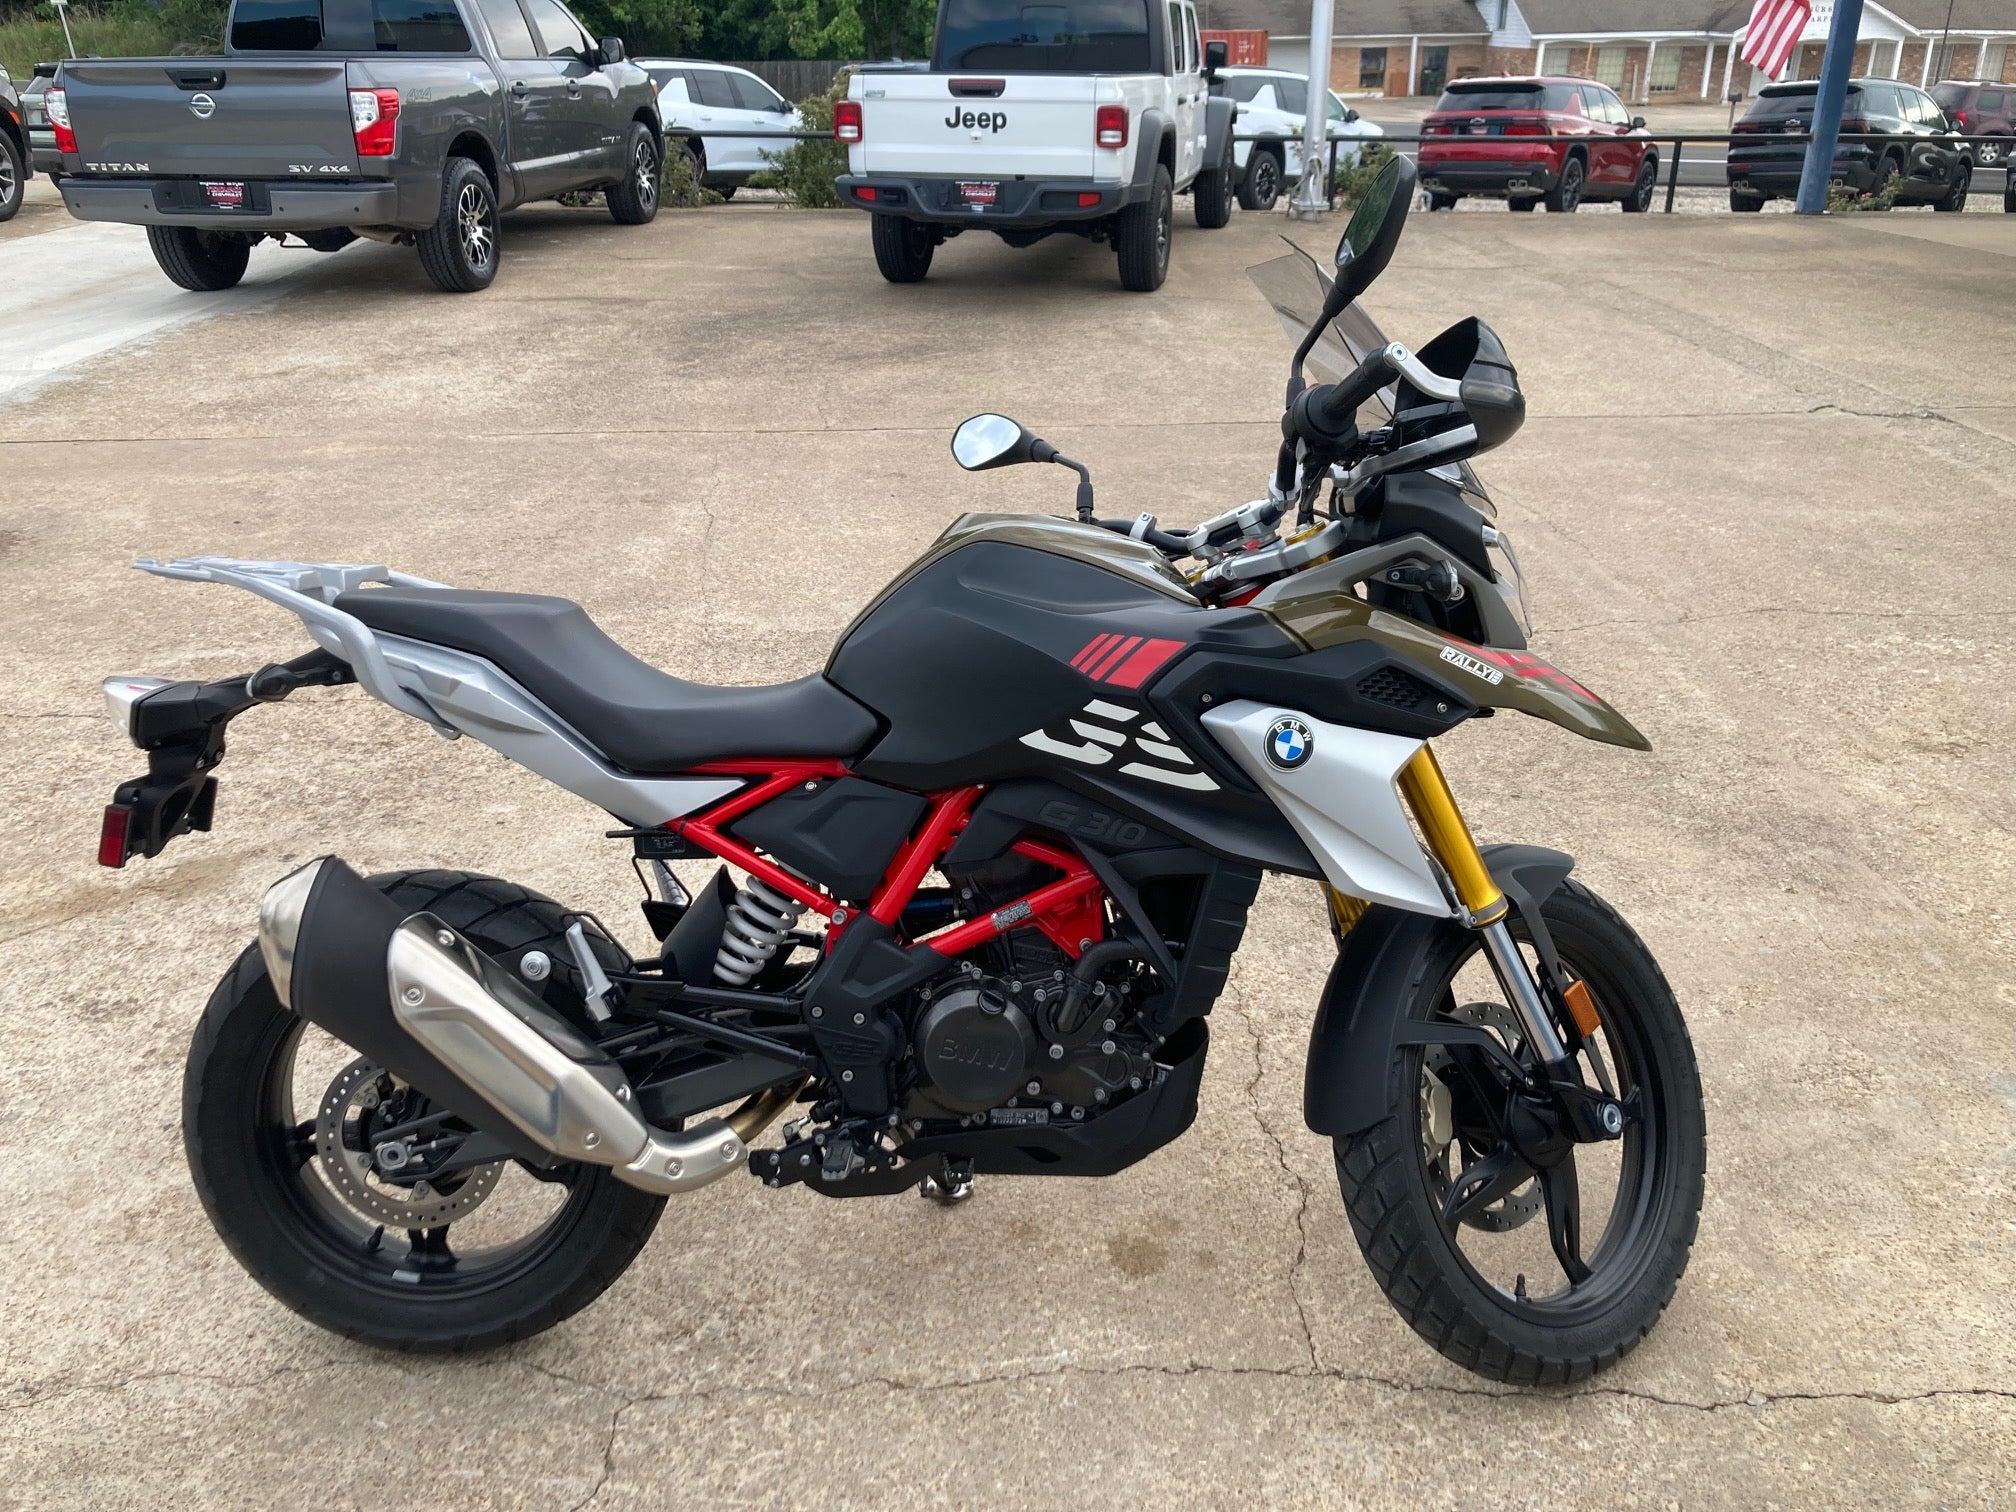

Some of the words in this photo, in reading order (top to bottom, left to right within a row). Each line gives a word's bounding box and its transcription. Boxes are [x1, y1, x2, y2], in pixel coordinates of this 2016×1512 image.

[944, 105, 1008, 134] Jeep
[85, 162, 150, 172] TITAN
[288, 164, 313, 173] SV
[1441, 647, 1502, 684] RALLYE
[1274, 719, 1313, 743] BMW
[1039, 799, 1081, 829] G
[1076, 811, 1148, 848] 310
[938, 1037, 1015, 1072] BMW
